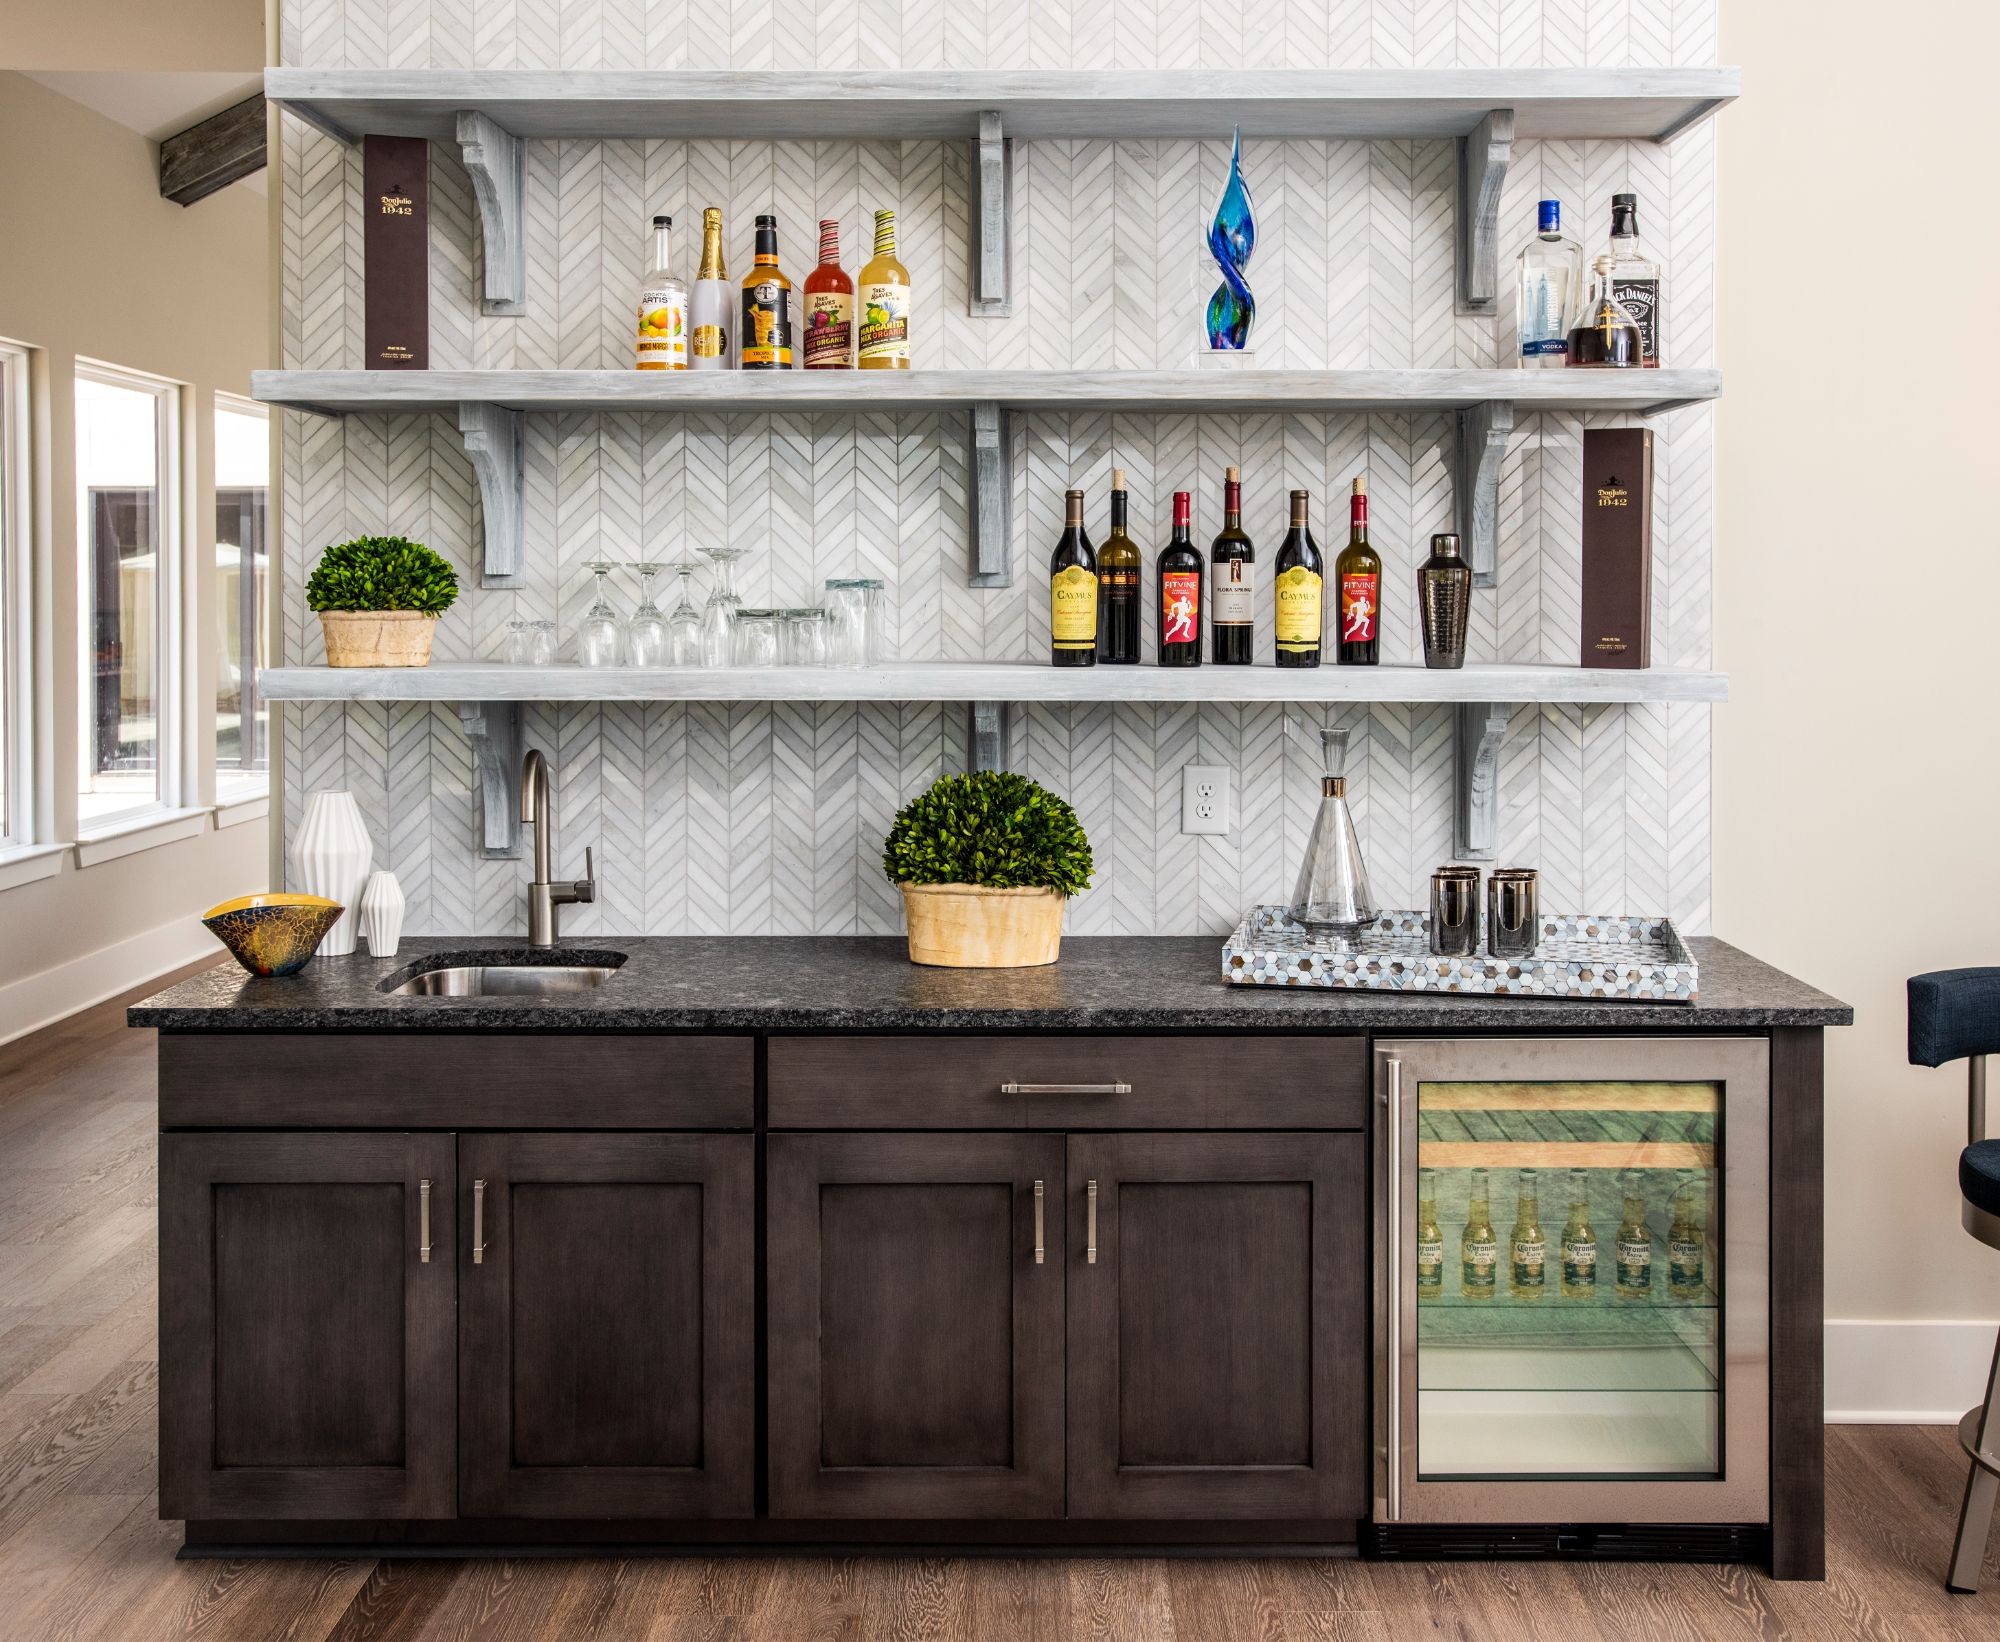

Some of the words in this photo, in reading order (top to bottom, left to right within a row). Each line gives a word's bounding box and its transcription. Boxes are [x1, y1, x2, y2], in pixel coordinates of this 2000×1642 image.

[381, 206, 412, 215] 1942
[760, 286, 772, 300] T
[642, 296, 672, 304] ARTIST
[860, 320, 905, 336] MARGARITA
[860, 334, 872, 344] MIX
[872, 327, 905, 339] ORGANIC
[694, 336, 724, 345] BELAE
[816, 336, 846, 347] ORGANIC
[1599, 498, 1628, 506] 1942
[1164, 581, 1197, 590] FITVINE
[1343, 581, 1377, 591] FITVINE
[1056, 590, 1092, 600] CAYMUS
[1280, 591, 1316, 600] CAYMUS
